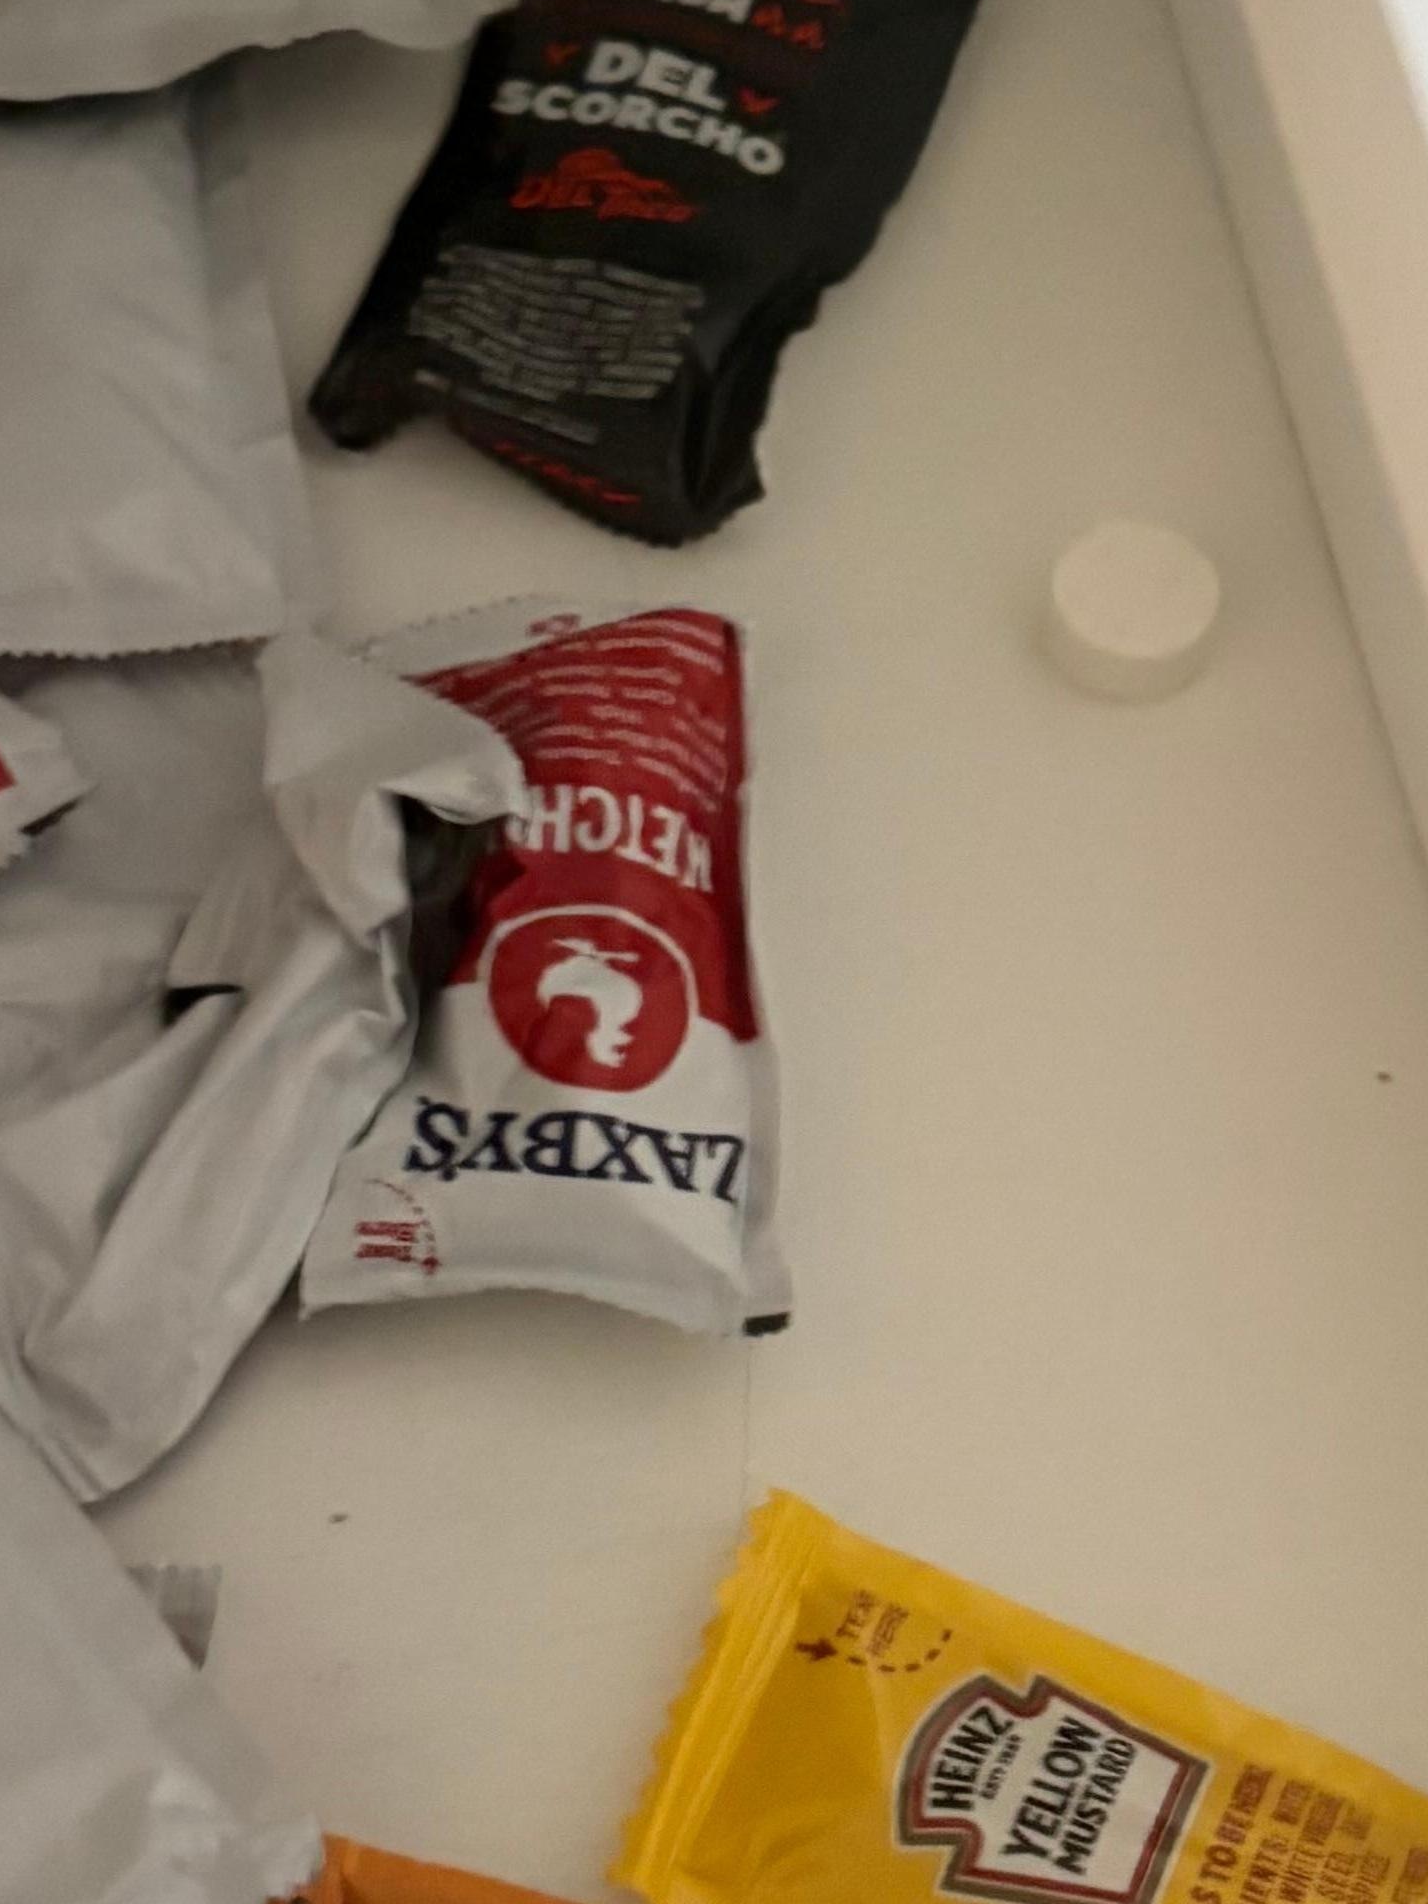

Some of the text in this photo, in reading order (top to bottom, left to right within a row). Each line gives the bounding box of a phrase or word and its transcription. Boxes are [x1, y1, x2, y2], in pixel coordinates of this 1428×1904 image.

[491, 79, 787, 177] SCORCHO
[585, 40, 727, 110] DEL
[402, 1096, 748, 1208] ZAXBY'S
[930, 1701, 1014, 1809] HEINZ
[997, 1713, 1104, 1860] YELLOW
[1052, 1733, 1139, 1877] MUSTARD
[1200, 1843, 1240, 1885] TO
